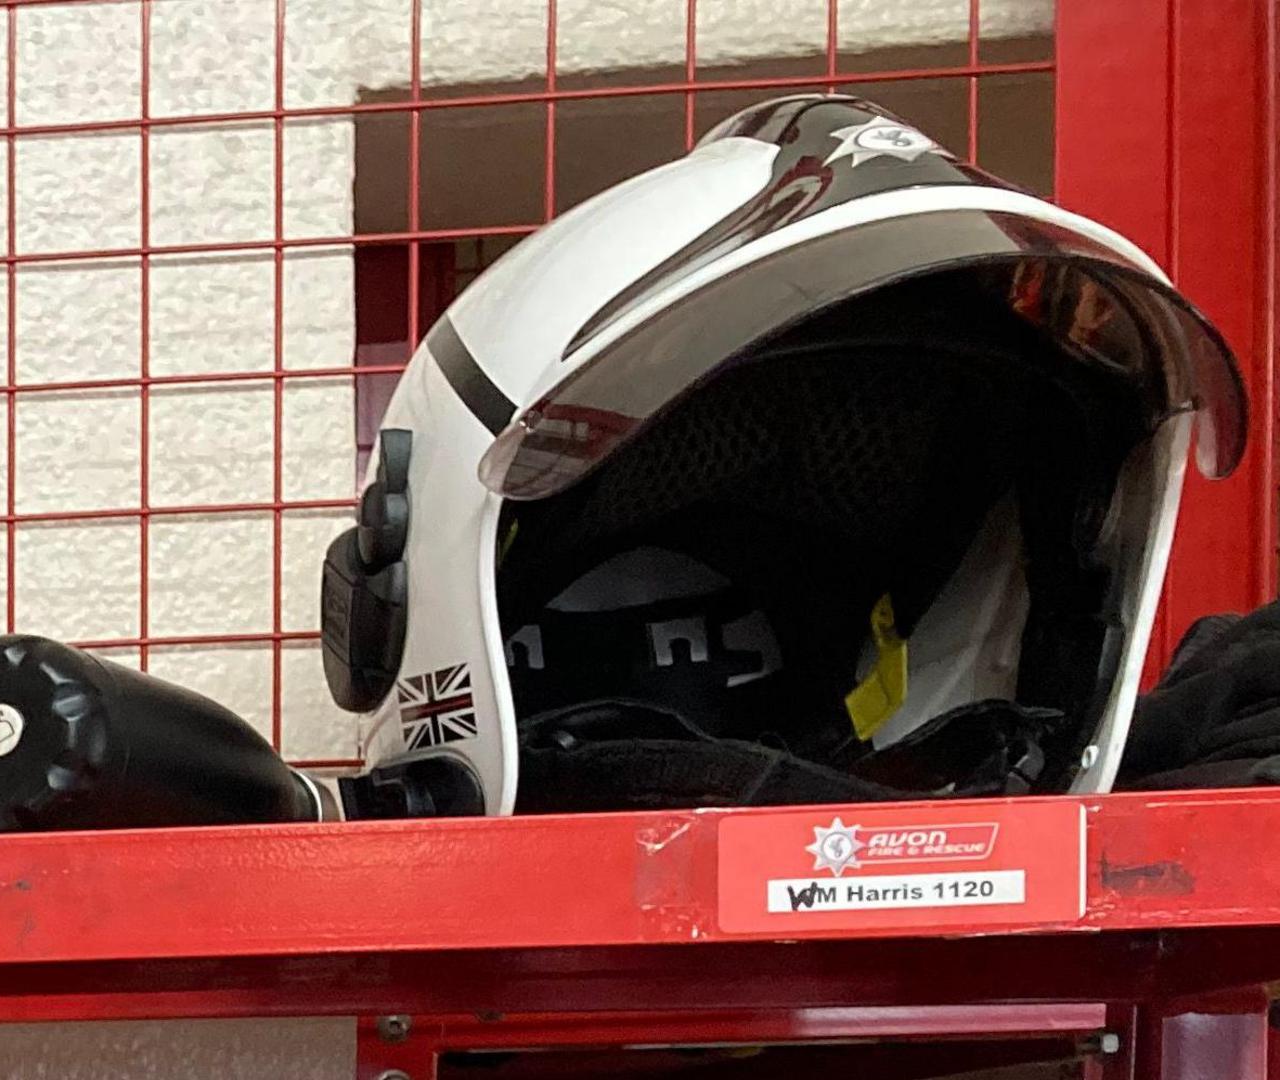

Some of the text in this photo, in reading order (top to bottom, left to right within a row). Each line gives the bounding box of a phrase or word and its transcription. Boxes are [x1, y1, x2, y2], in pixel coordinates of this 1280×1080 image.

[869, 830, 947, 847] AVON
[868, 845, 903, 857] FIRE
[923, 842, 986, 855] RESCUE
[847, 884, 923, 902] Harris
[933, 880, 994, 899] 1120
